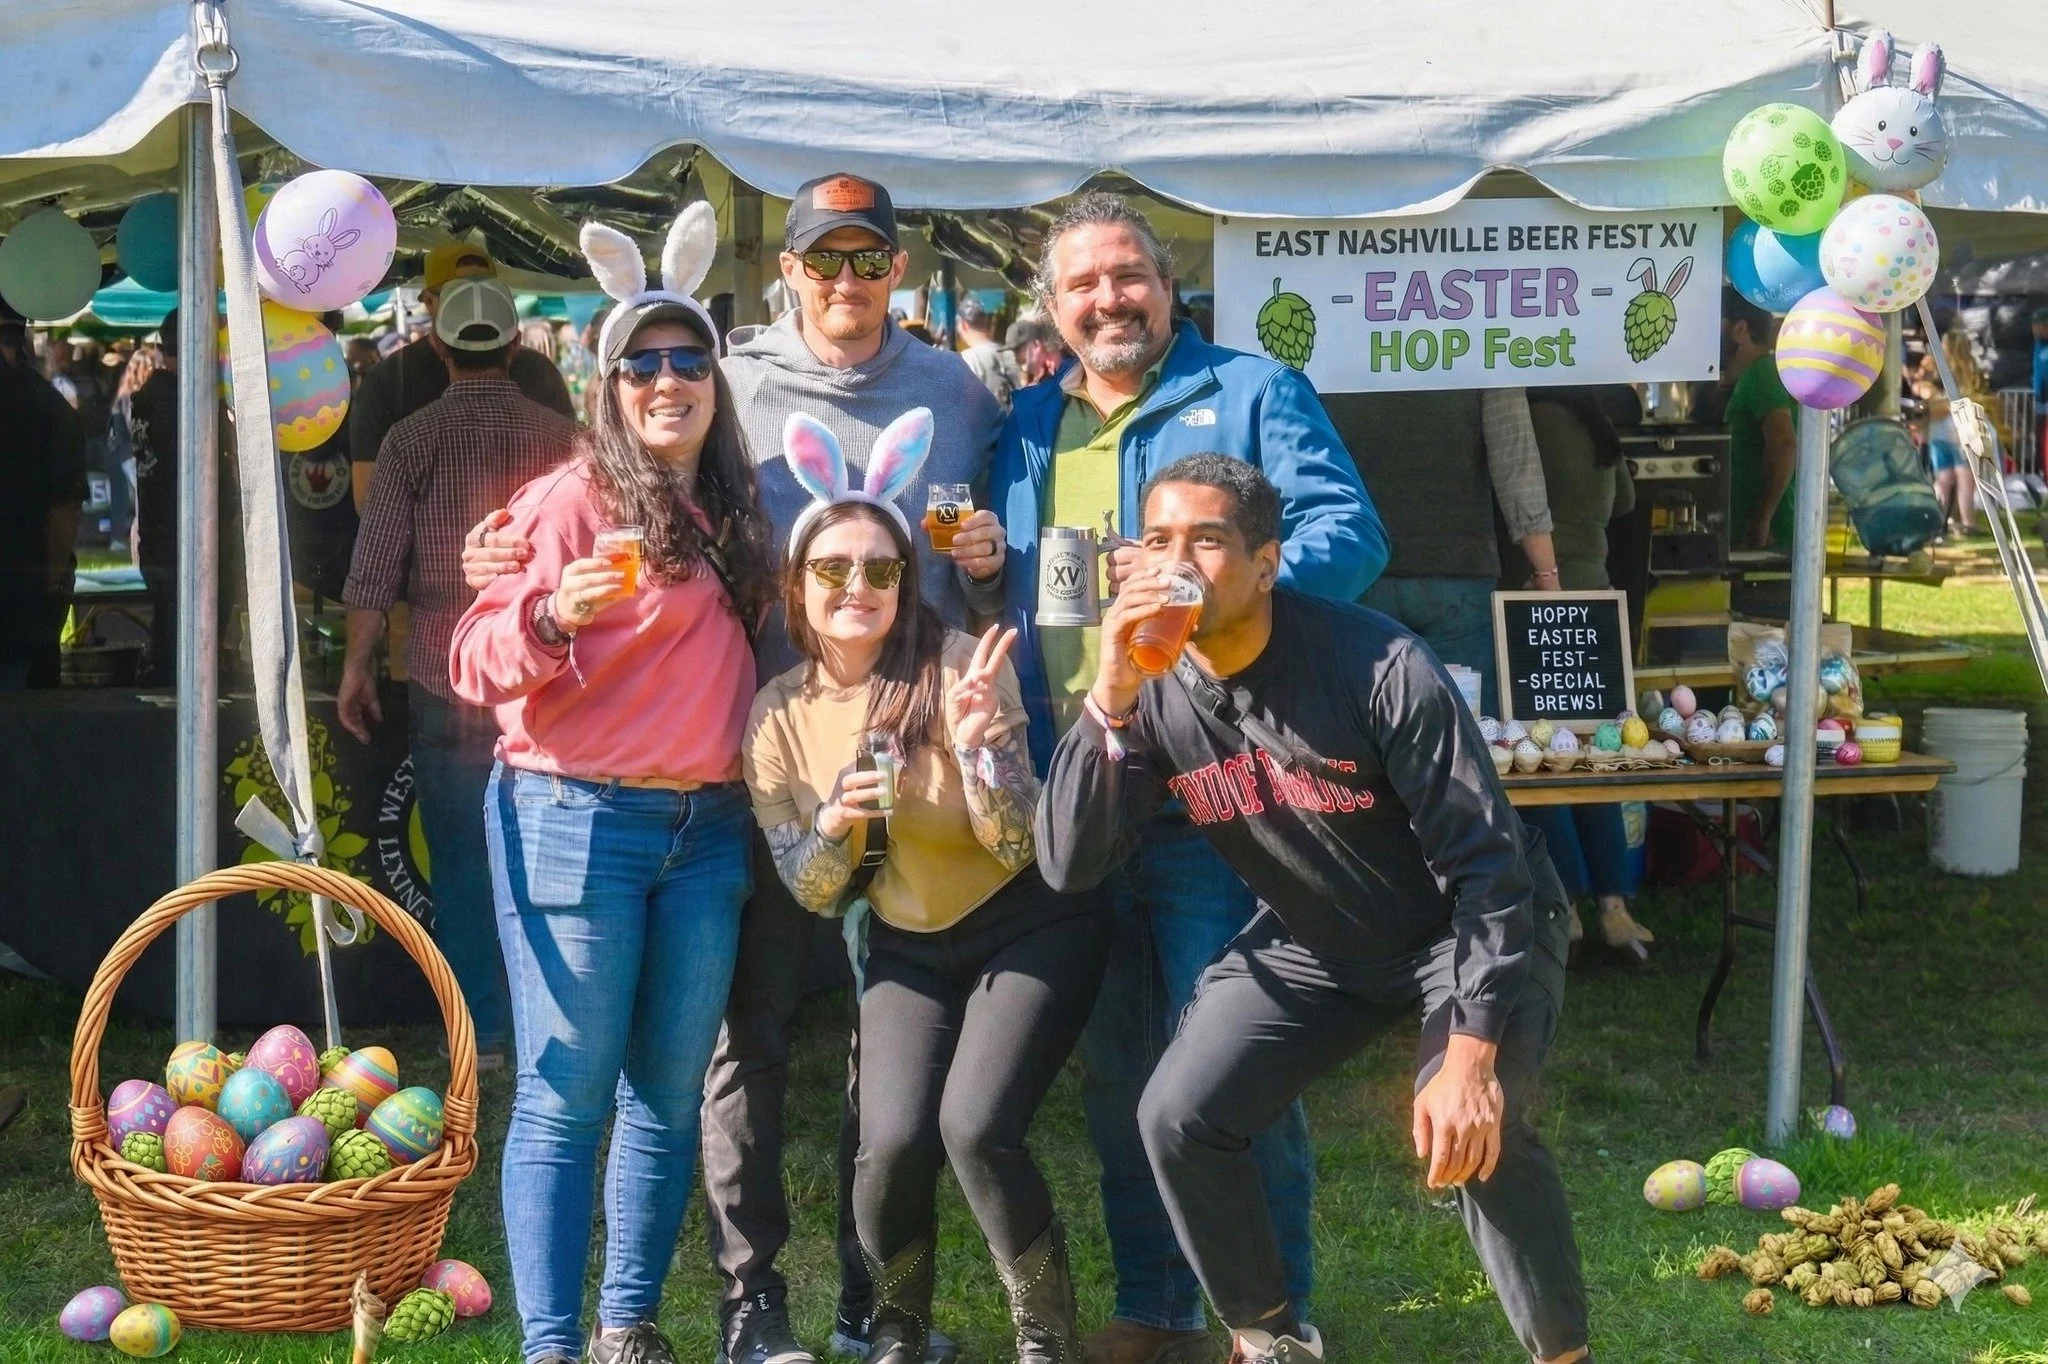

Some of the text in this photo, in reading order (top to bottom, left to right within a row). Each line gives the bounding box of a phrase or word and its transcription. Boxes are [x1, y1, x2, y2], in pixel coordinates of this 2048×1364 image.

[1256, 222, 1698, 257] EAST NASHVILLE BEER FEST XV
[1364, 267, 1580, 322] EASTER
[1370, 327, 1576, 373] HOP Fest
[1053, 565, 1081, 587] XV
[1531, 606, 1589, 624] HOPPY
[1527, 628, 1598, 646] EASTER
[1533, 693, 1603, 711] BREWS!
